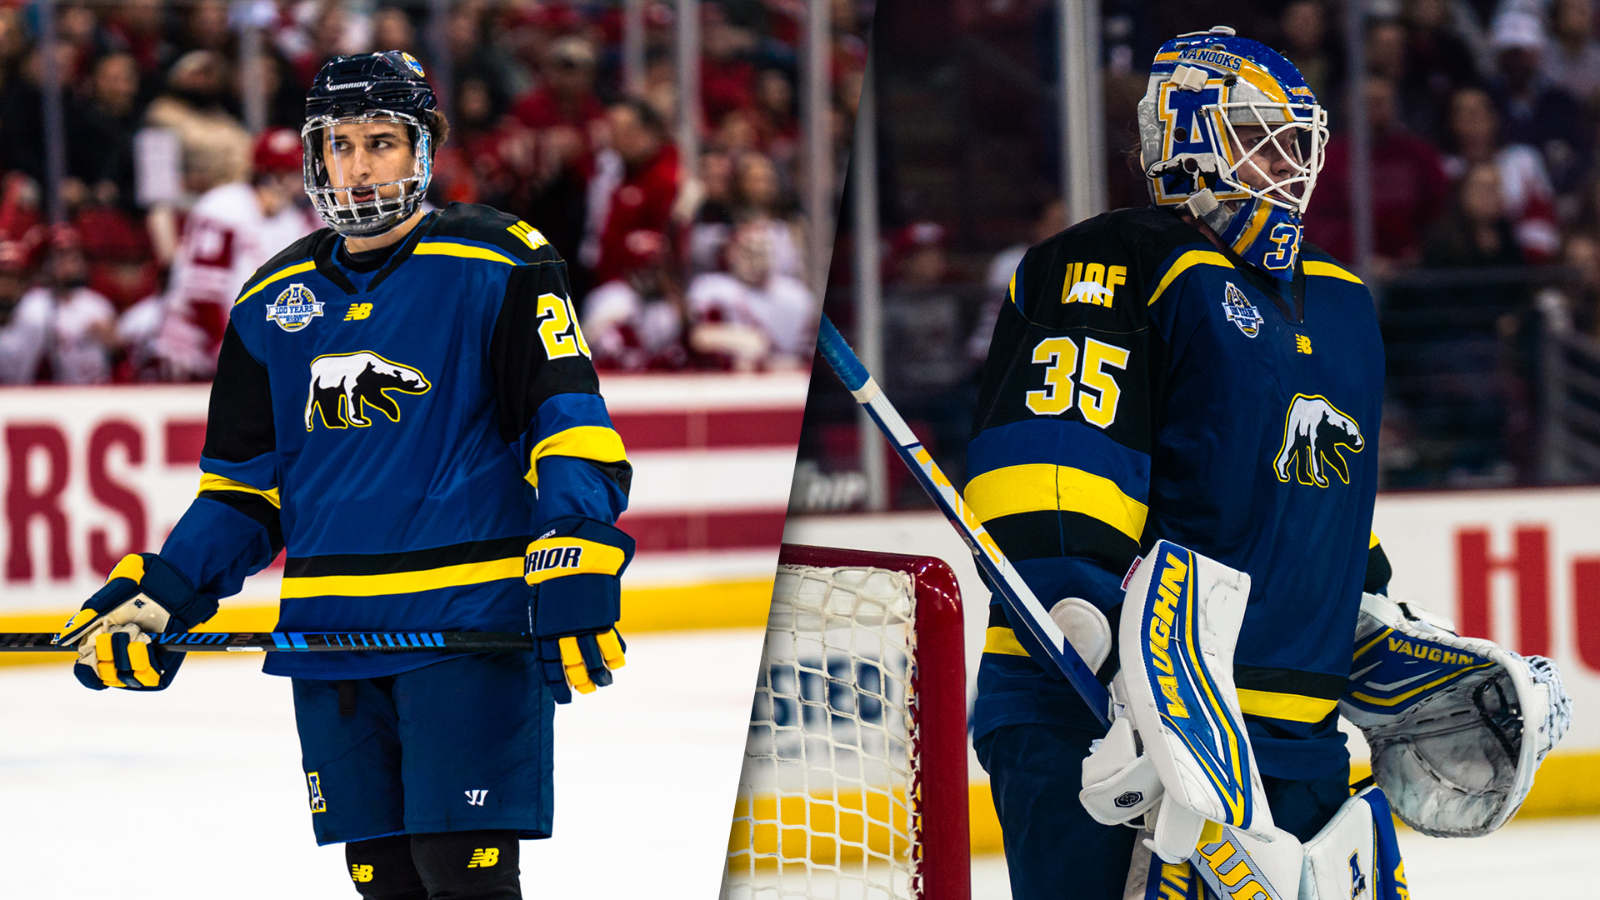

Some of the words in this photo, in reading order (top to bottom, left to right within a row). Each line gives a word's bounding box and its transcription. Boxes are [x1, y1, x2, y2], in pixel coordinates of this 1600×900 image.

[1177, 49, 1243, 73] NANOOKS
[328, 81, 369, 91] WARRIOR
[1263, 222, 1304, 271] 3
[1061, 262, 1127, 308] UAF
[289, 304, 314, 315] YEARS
[1025, 336, 1131, 430] 35
[524, 546, 583, 575] RIOR
[146, 632, 230, 645] VIUM
[1149, 552, 1188, 719] VAUGHN
[1387, 636, 1475, 666] VAUGHN
